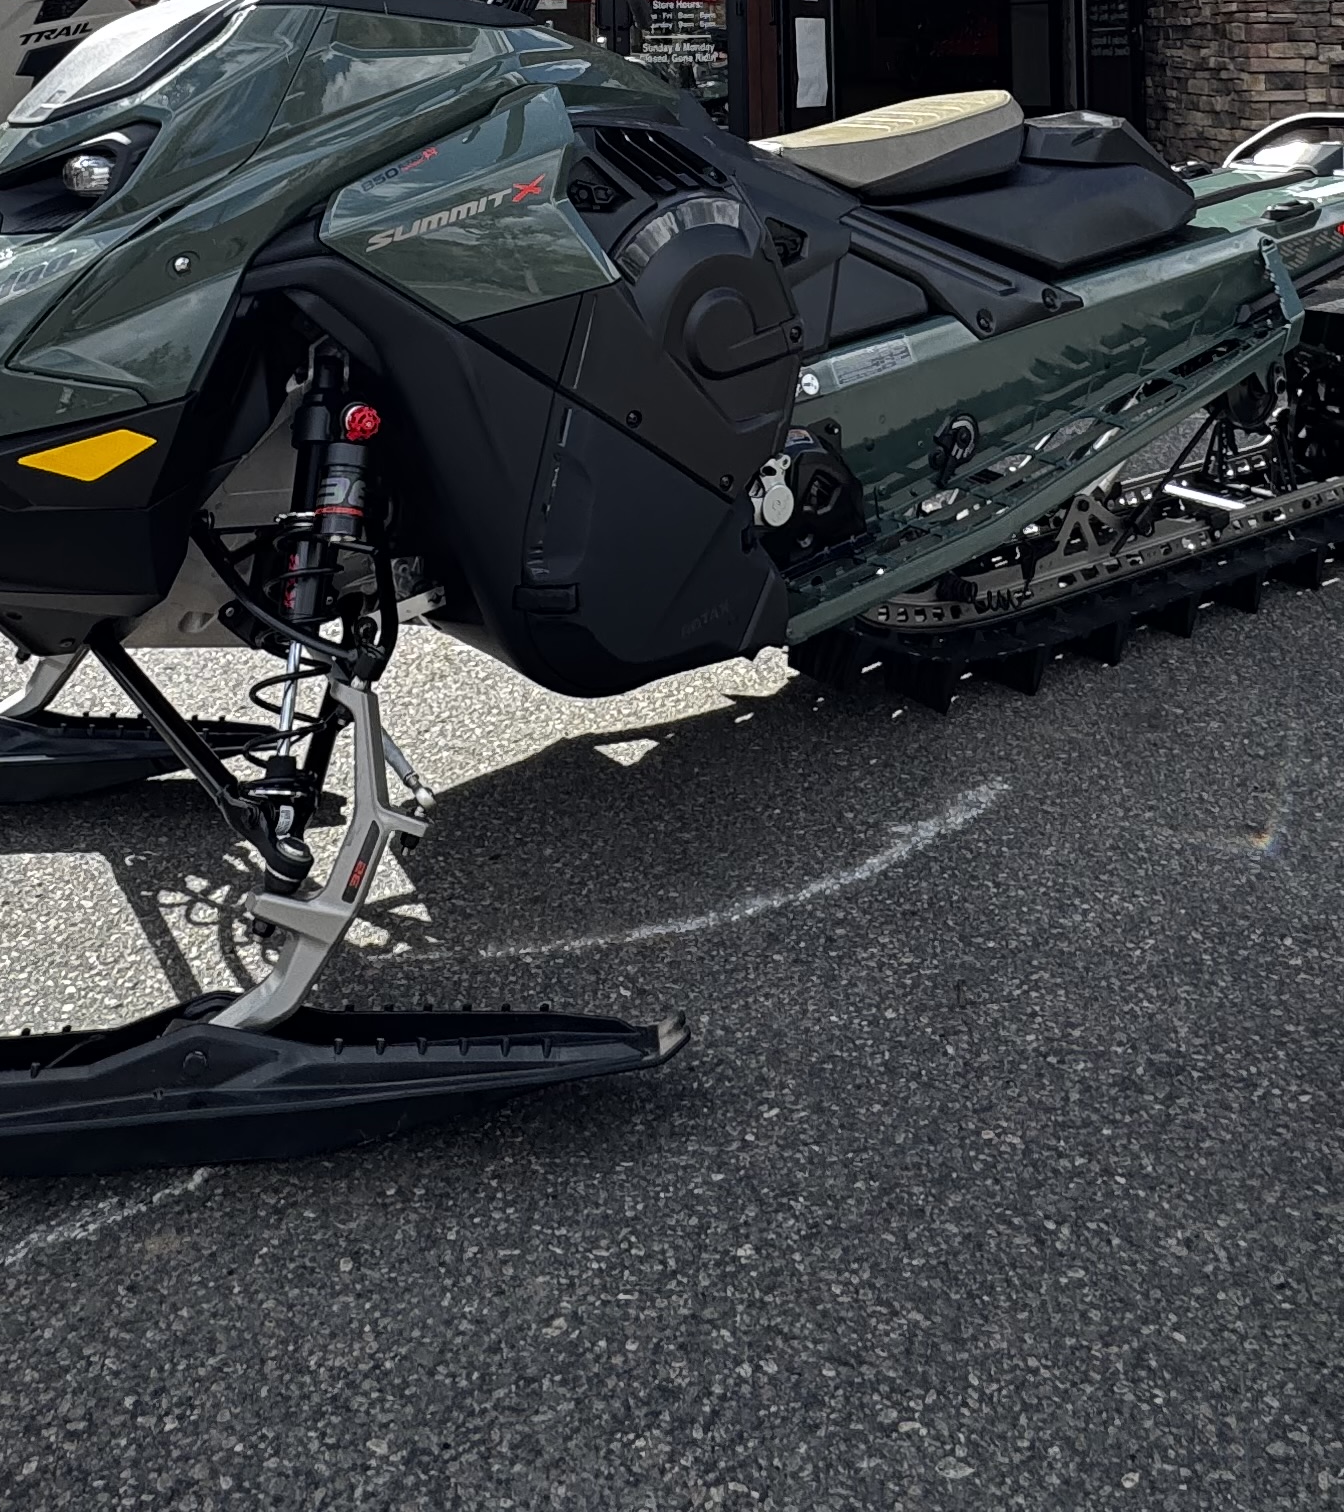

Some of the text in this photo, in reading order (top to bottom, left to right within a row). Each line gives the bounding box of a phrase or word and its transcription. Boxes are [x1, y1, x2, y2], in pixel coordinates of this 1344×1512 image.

[652, 0, 674, 9] Store
[19, 22, 93, 46] TRAIL
[642, 43, 673, 54] Sunday
[683, 43, 715, 53] Monday
[671, 54, 693, 63] Gone
[360, 167, 399, 193] 850
[365, 173, 546, 253] SUMMIT X
